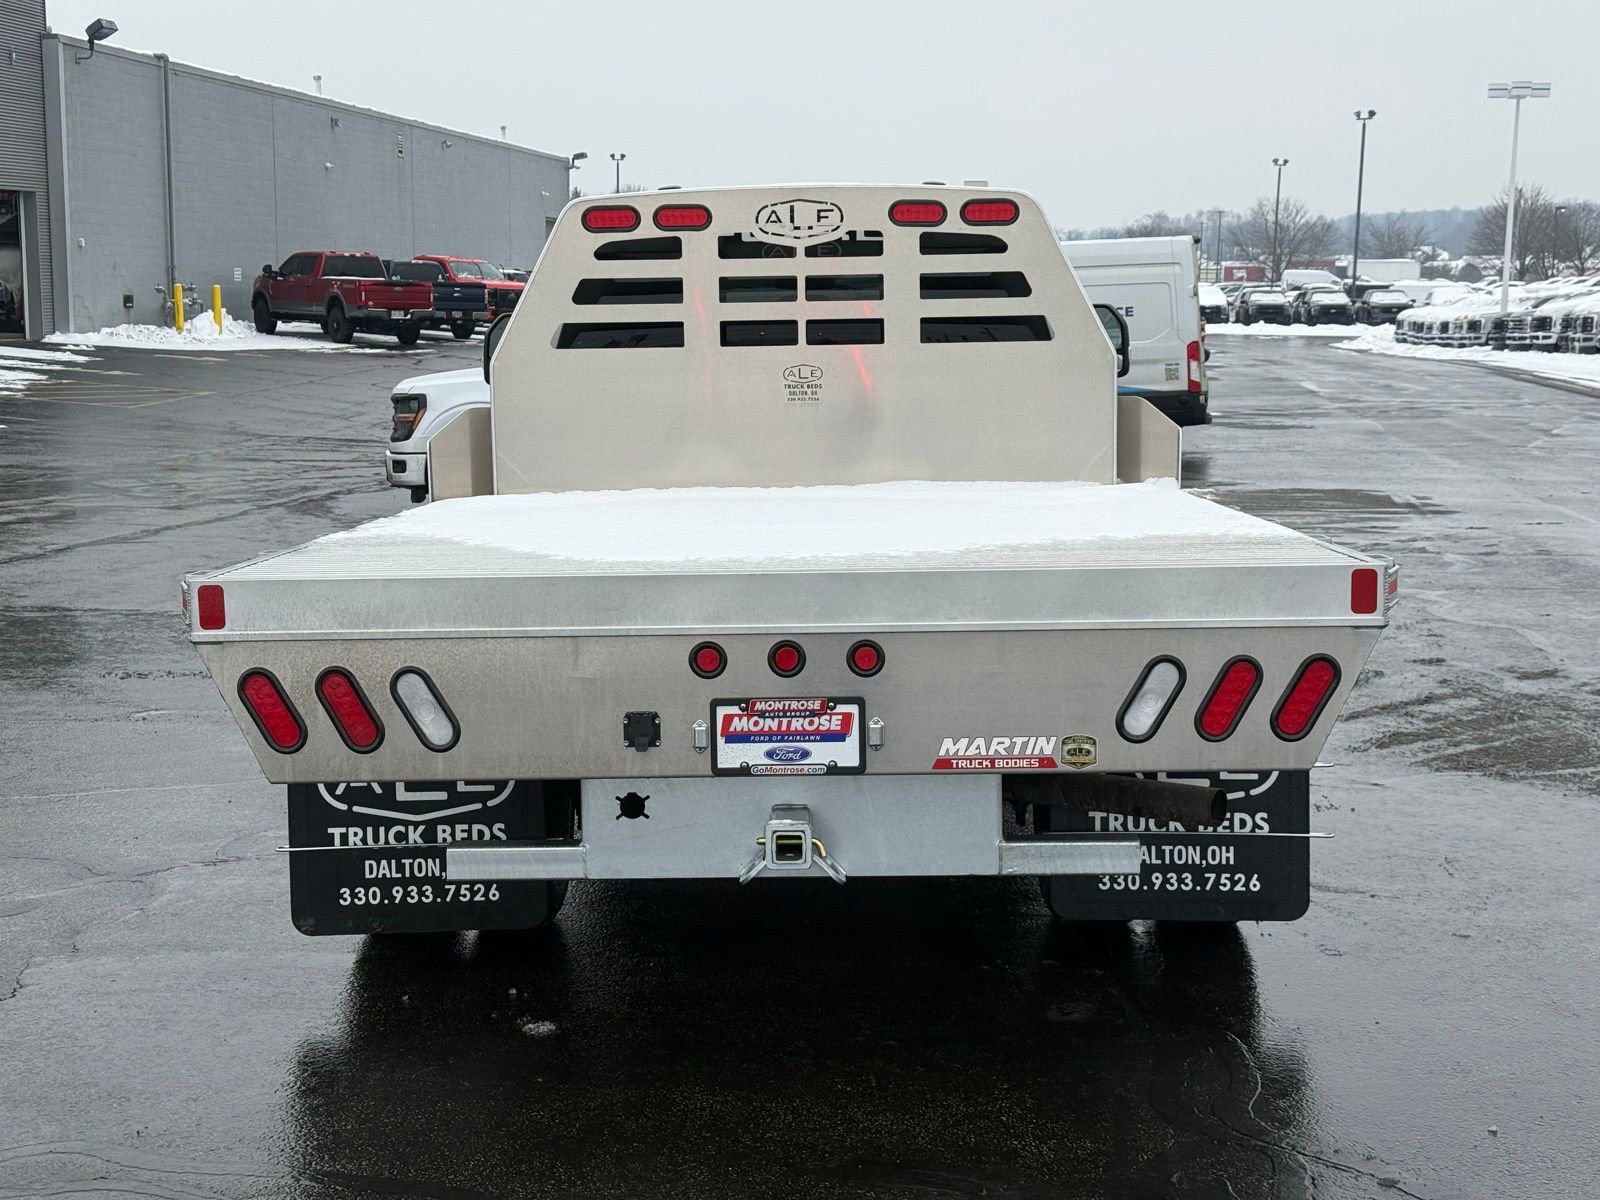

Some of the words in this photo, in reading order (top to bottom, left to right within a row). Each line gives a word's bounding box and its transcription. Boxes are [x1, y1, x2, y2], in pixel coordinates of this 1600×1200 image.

[787, 368, 818, 379] ALE
[754, 700, 822, 711] MONTROSE
[729, 715, 843, 732] MONTROSE
[773, 747, 803, 760] Ford
[938, 736, 1057, 756] MARTIN
[752, 766, 826, 774] GoMontrose.com
[951, 759, 991, 768] TRUCK
[994, 758, 1039, 768] BODIES
[327, 825, 426, 848] TRUCK
[364, 858, 446, 880] DALTON,
[1098, 872, 1261, 892] 330.933.7526
[338, 883, 500, 906] 330.933.7526
